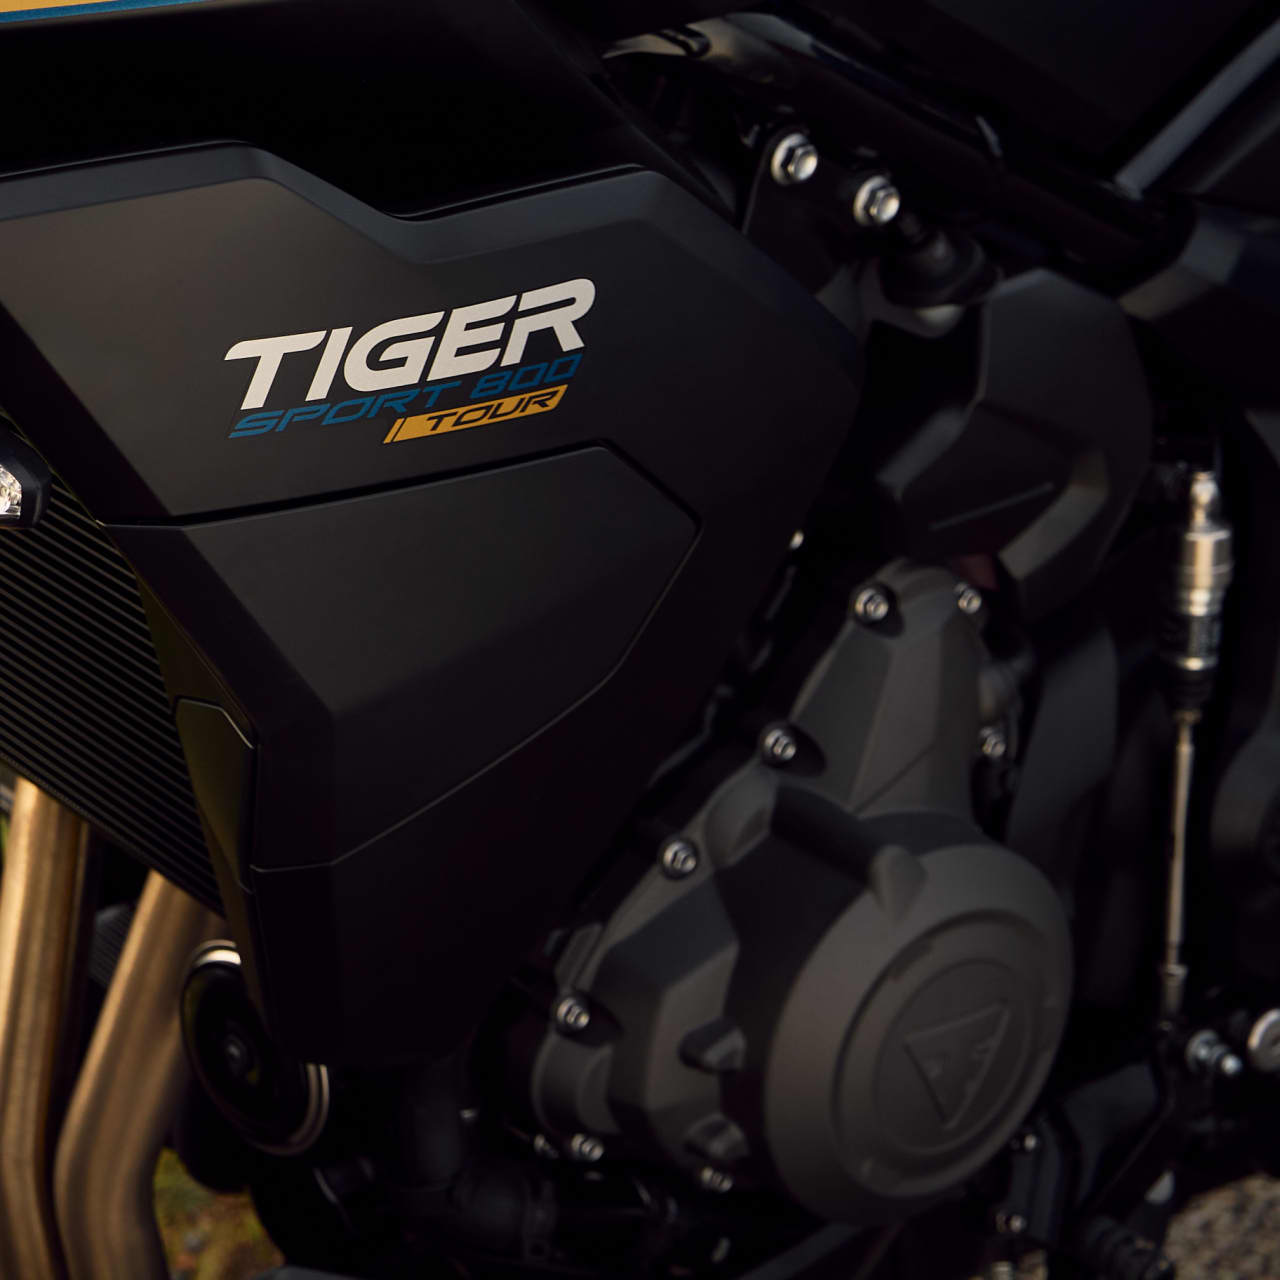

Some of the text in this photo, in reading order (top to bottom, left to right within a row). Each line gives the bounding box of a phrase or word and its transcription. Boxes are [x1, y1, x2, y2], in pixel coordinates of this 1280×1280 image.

[224, 278, 596, 410] TIGER
[228, 354, 583, 438] SPORT 800
[426, 389, 560, 432] TOUR
